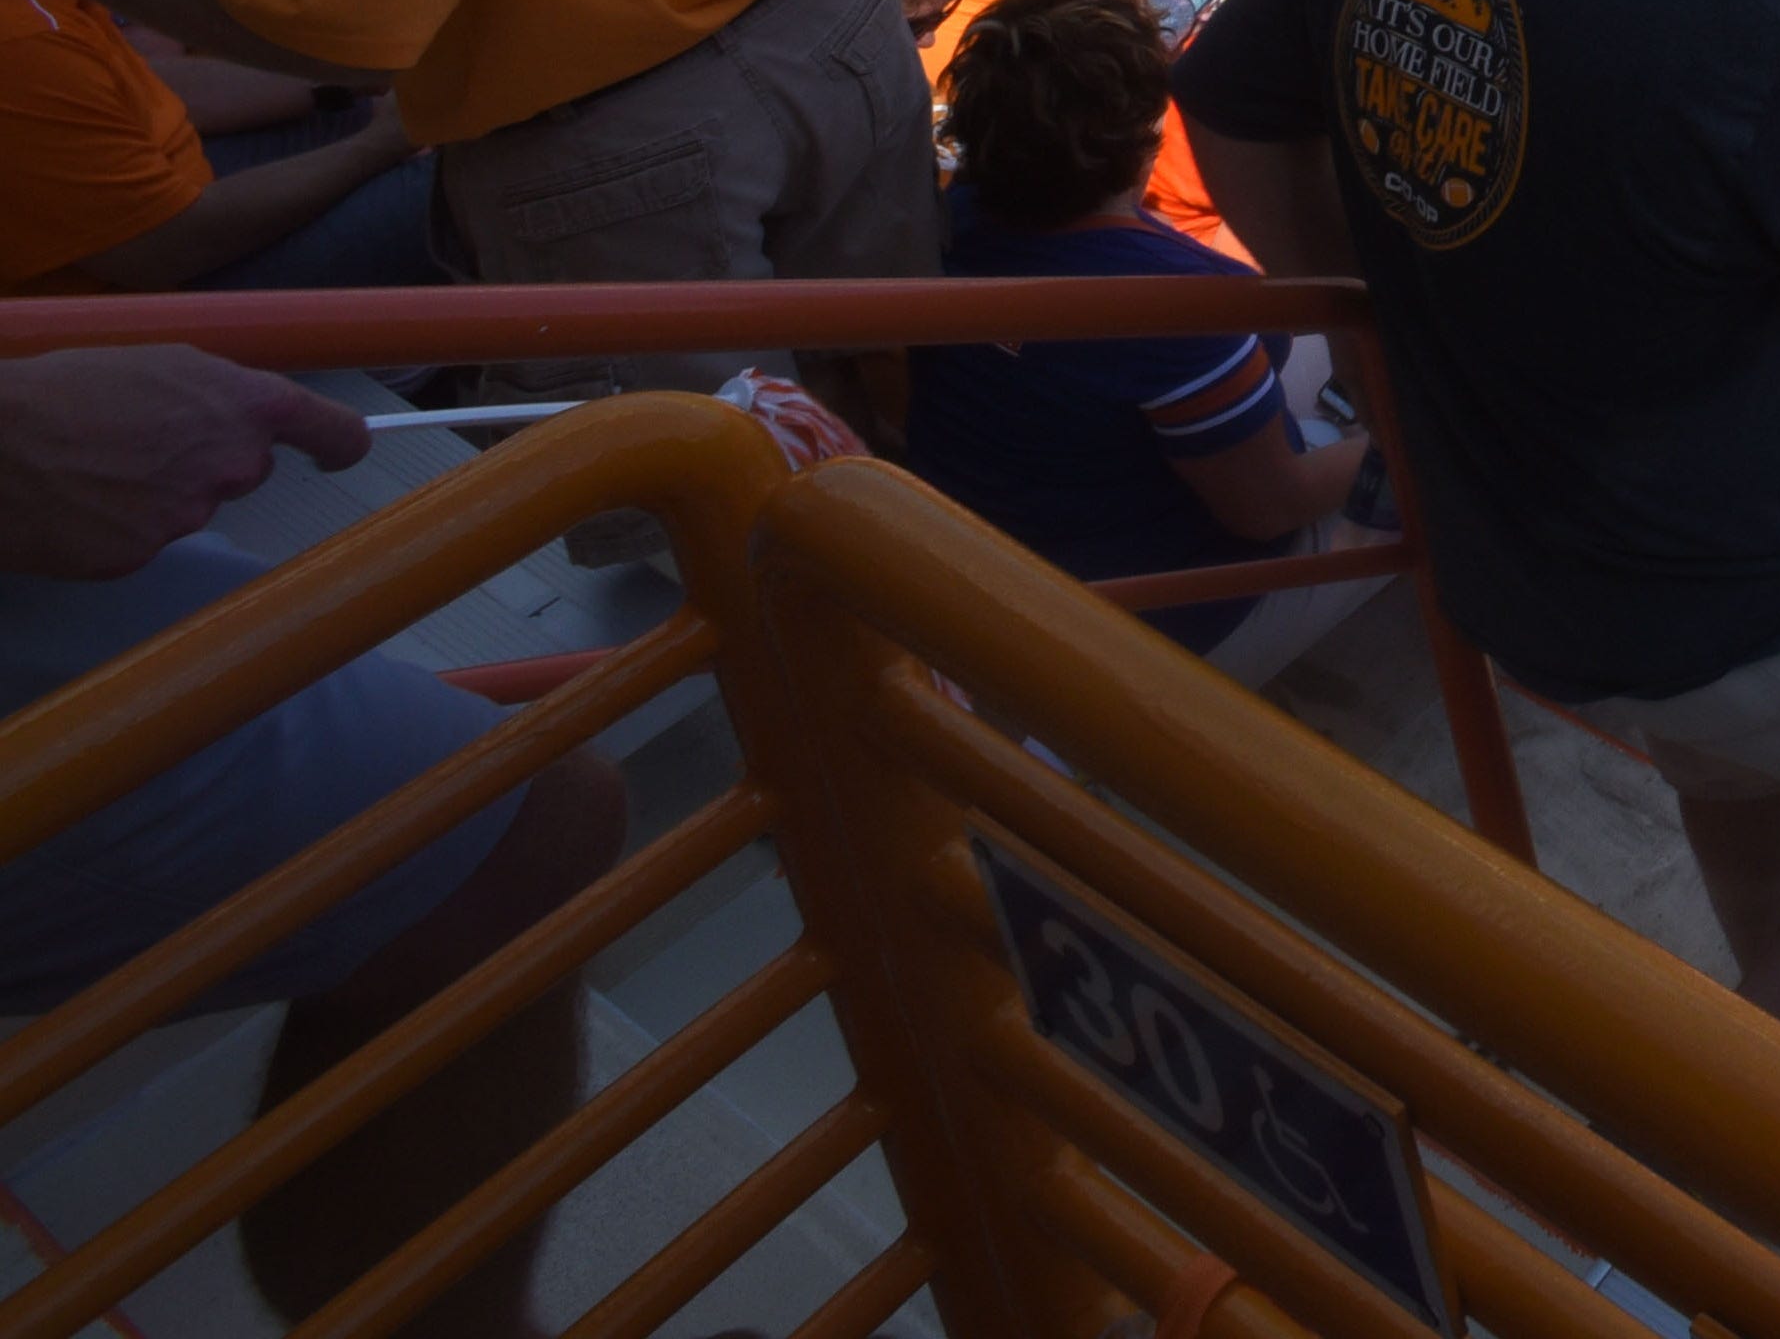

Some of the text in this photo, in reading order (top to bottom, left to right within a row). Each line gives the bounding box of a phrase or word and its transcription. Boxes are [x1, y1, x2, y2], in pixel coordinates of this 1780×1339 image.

[1352, 18, 1501, 119] HOME FIELD
[1431, 21, 1495, 78] OUR
[1354, 56, 1494, 177] TAKE CARE
